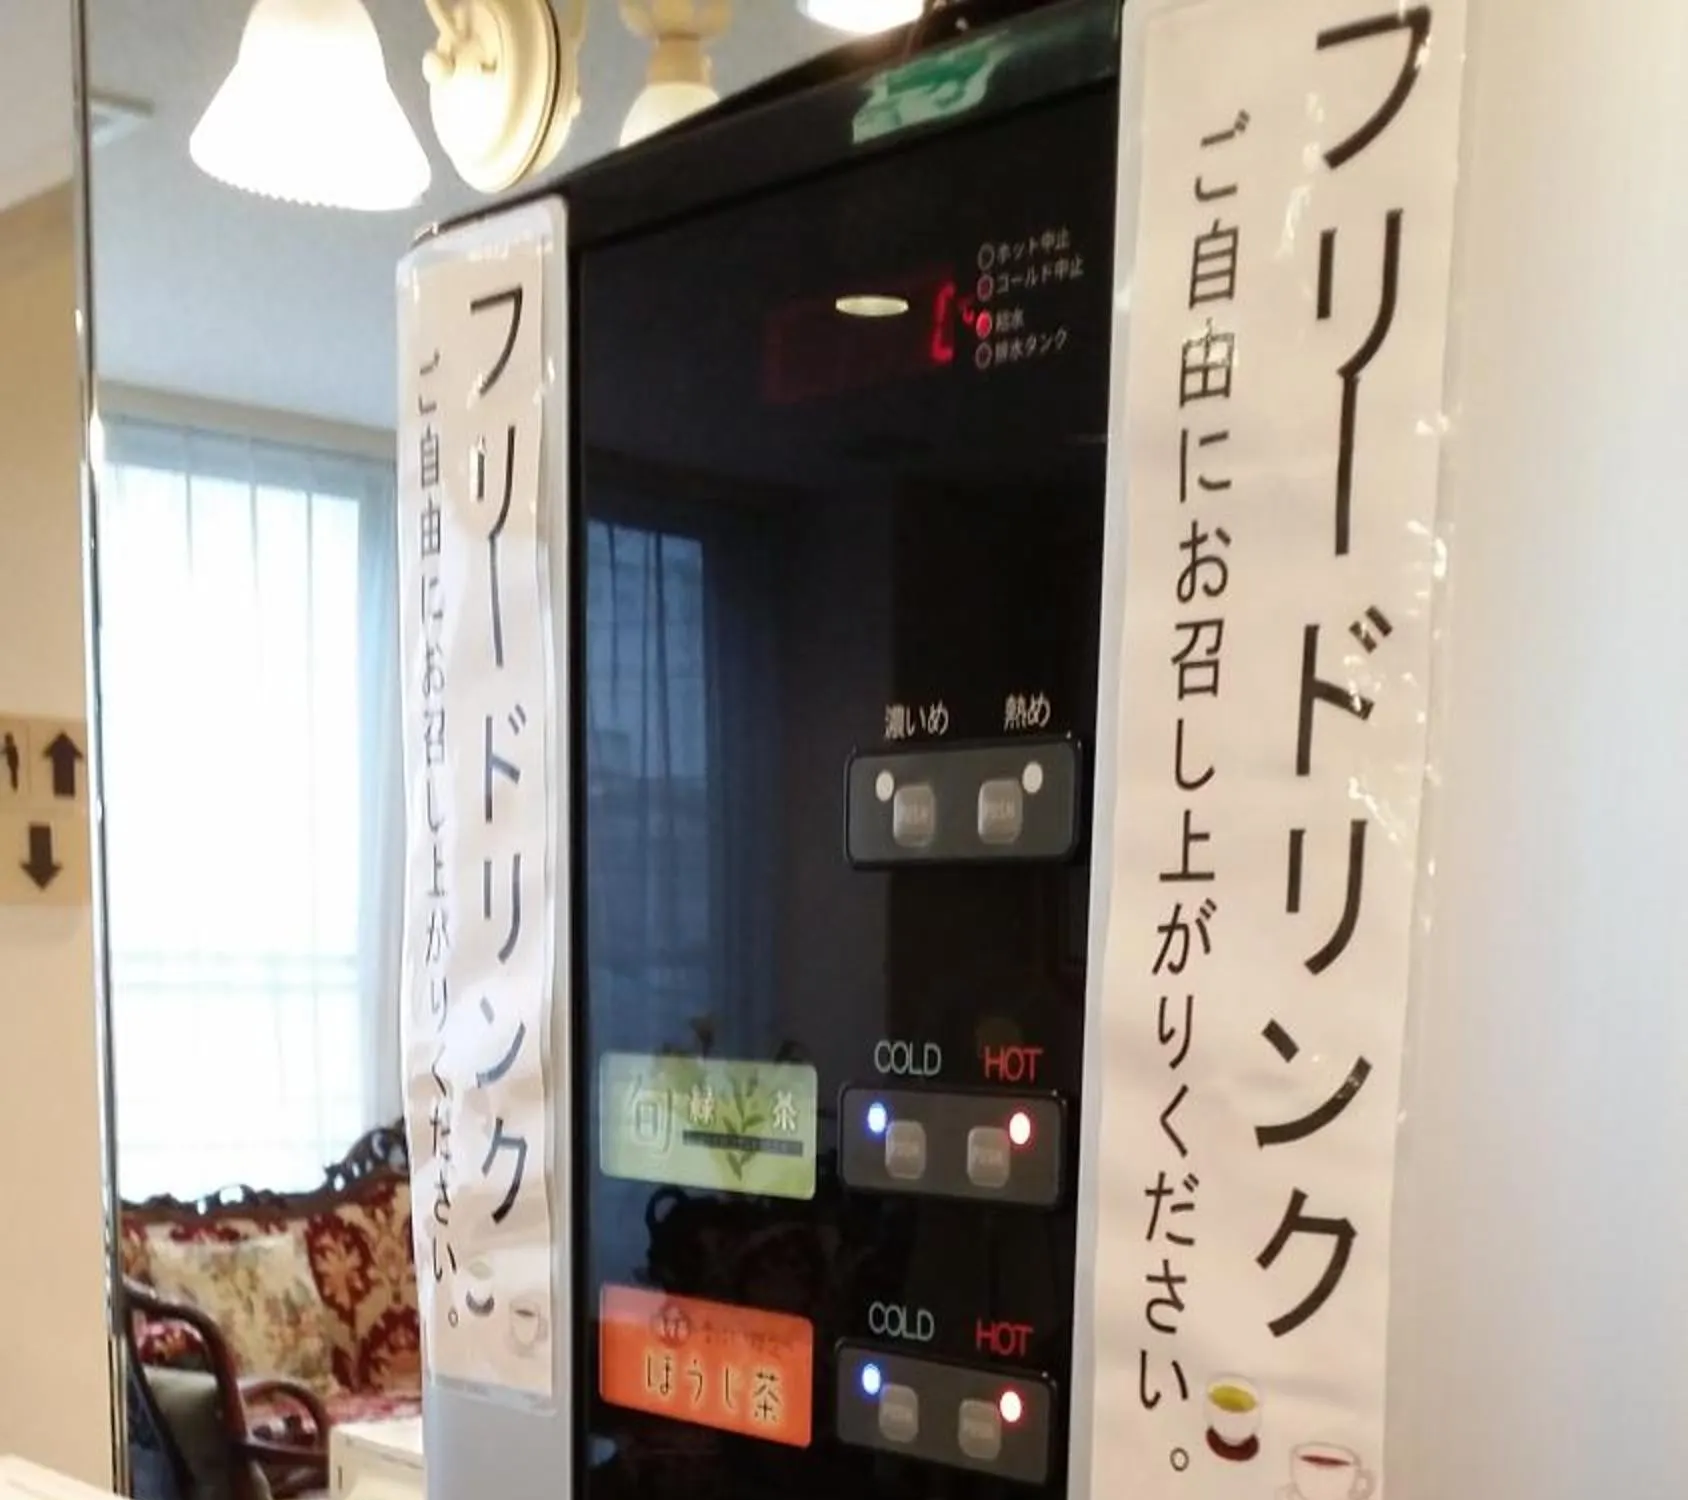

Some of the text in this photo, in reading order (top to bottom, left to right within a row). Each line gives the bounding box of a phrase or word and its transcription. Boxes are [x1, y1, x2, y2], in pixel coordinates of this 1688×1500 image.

[1254, 4, 1432, 1338] フリードリンク
[470, 284, 527, 1224] フリードリンク
[1138, 109, 1250, 1472] ご自由にお召し上がりください。
[874, 1041, 942, 1075] COLD
[984, 1046, 1043, 1081] HOT
[869, 1302, 935, 1341] COLD
[976, 1318, 1033, 1356] HOT
[646, 1355, 781, 1421] ほうじ茶
